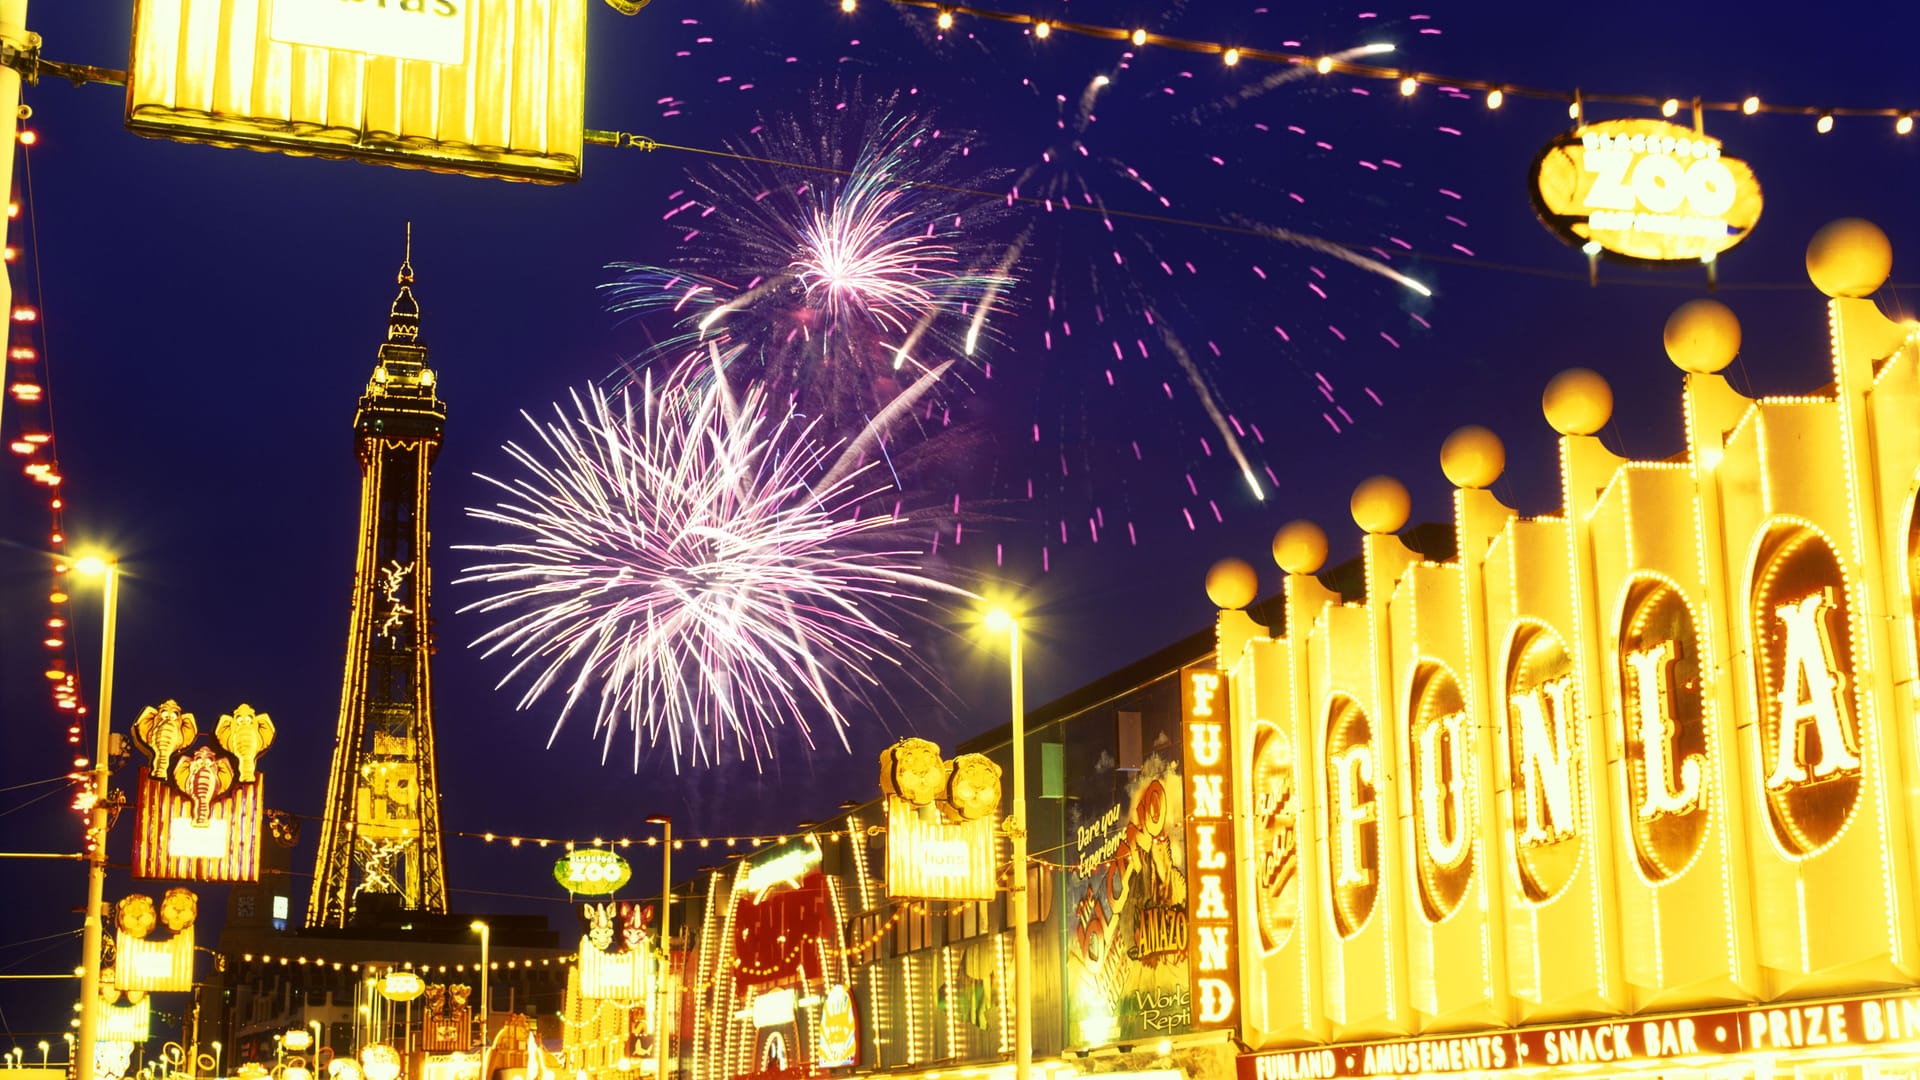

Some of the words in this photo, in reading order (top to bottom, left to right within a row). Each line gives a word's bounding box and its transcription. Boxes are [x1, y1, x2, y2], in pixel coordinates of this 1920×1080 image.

[1583, 151, 1737, 217] ZOO
[1077, 820, 1100, 852] Dare
[1101, 803, 1121, 838] you
[1189, 672, 1235, 1024] FUNLAND
[568, 863, 621, 883] ZOO
[1255, 1050, 1336, 1080] FUNLAND
[1363, 1036, 1506, 1075] AMUSEMENTS
[1544, 1024, 1633, 1065] SNACK
[1643, 1018, 1699, 1057] BAR
[1749, 1004, 1848, 1049] PRIZE
